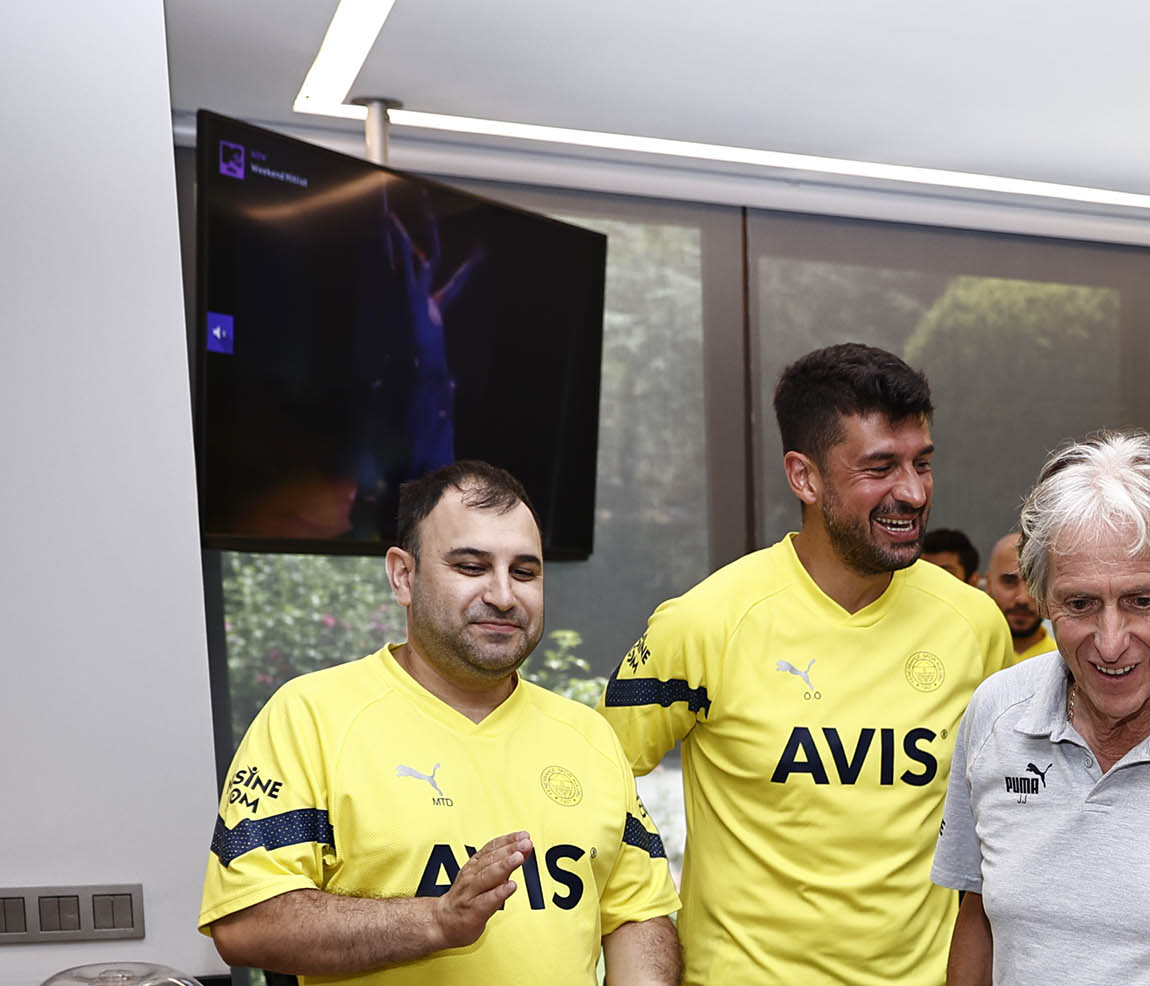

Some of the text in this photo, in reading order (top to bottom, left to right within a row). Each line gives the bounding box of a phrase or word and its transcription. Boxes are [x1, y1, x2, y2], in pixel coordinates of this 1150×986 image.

[770, 726, 939, 787] AVIS
[432, 797, 454, 807] MTD
[1004, 776, 1039, 794] PUMA
[414, 843, 586, 911] AIS
